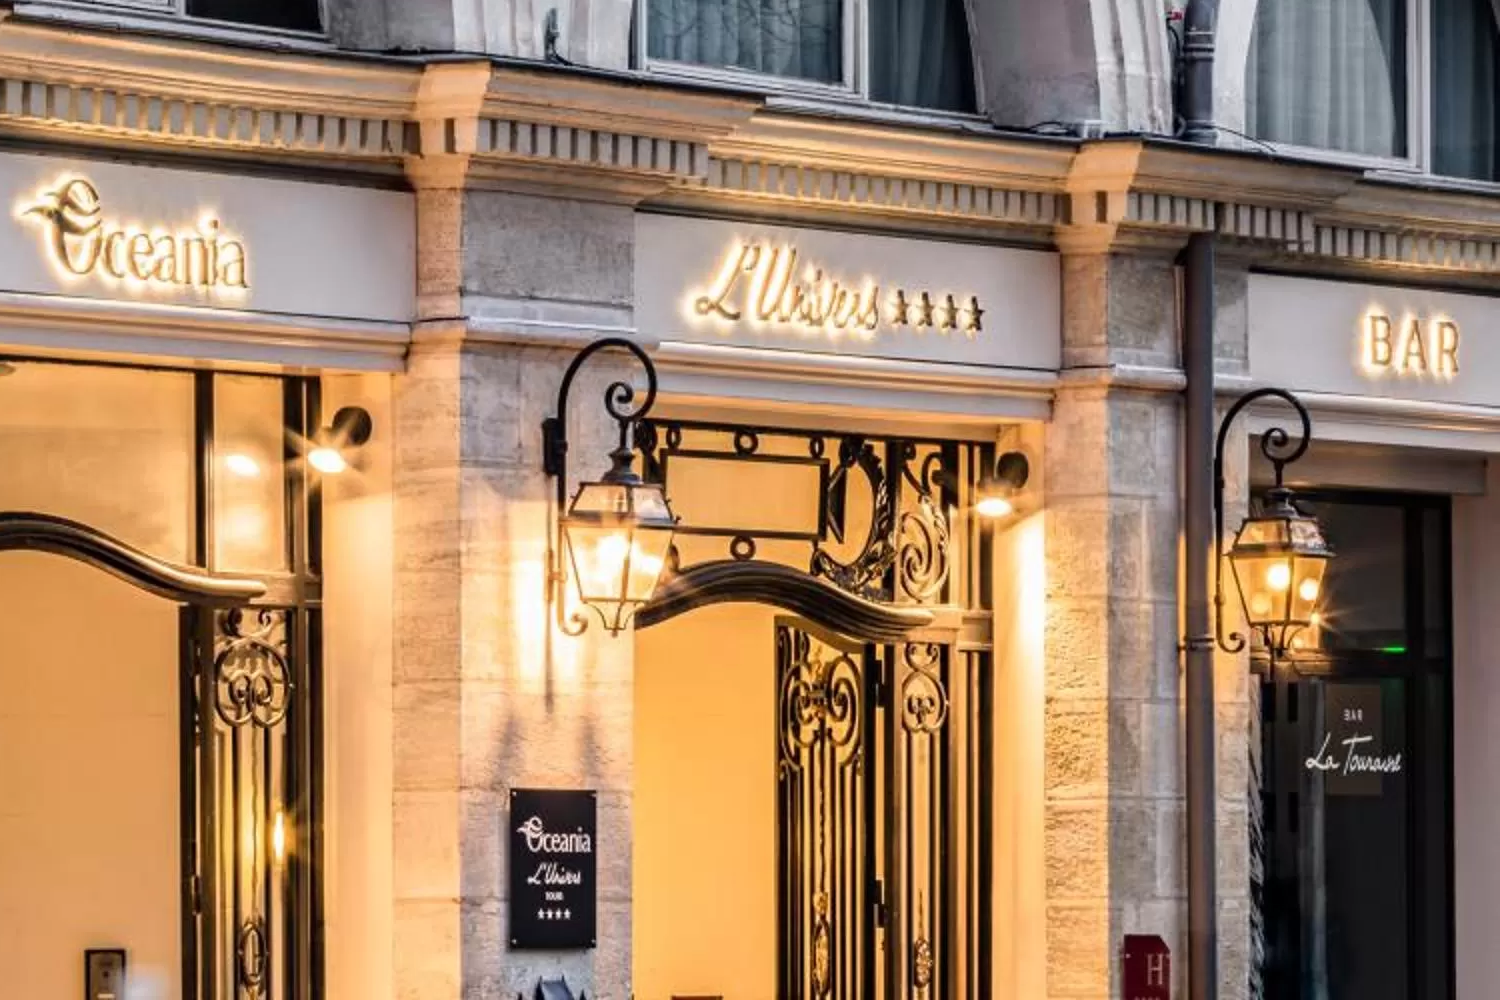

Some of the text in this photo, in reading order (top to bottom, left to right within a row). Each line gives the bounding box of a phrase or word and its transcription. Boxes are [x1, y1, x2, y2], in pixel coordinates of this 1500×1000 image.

[21, 178, 251, 290] Oceania
[695, 244, 880, 331] L'Univers
[1368, 314, 1460, 374] BAR
[1304, 731, 1341, 770] La
[516, 815, 592, 853] Oceania
